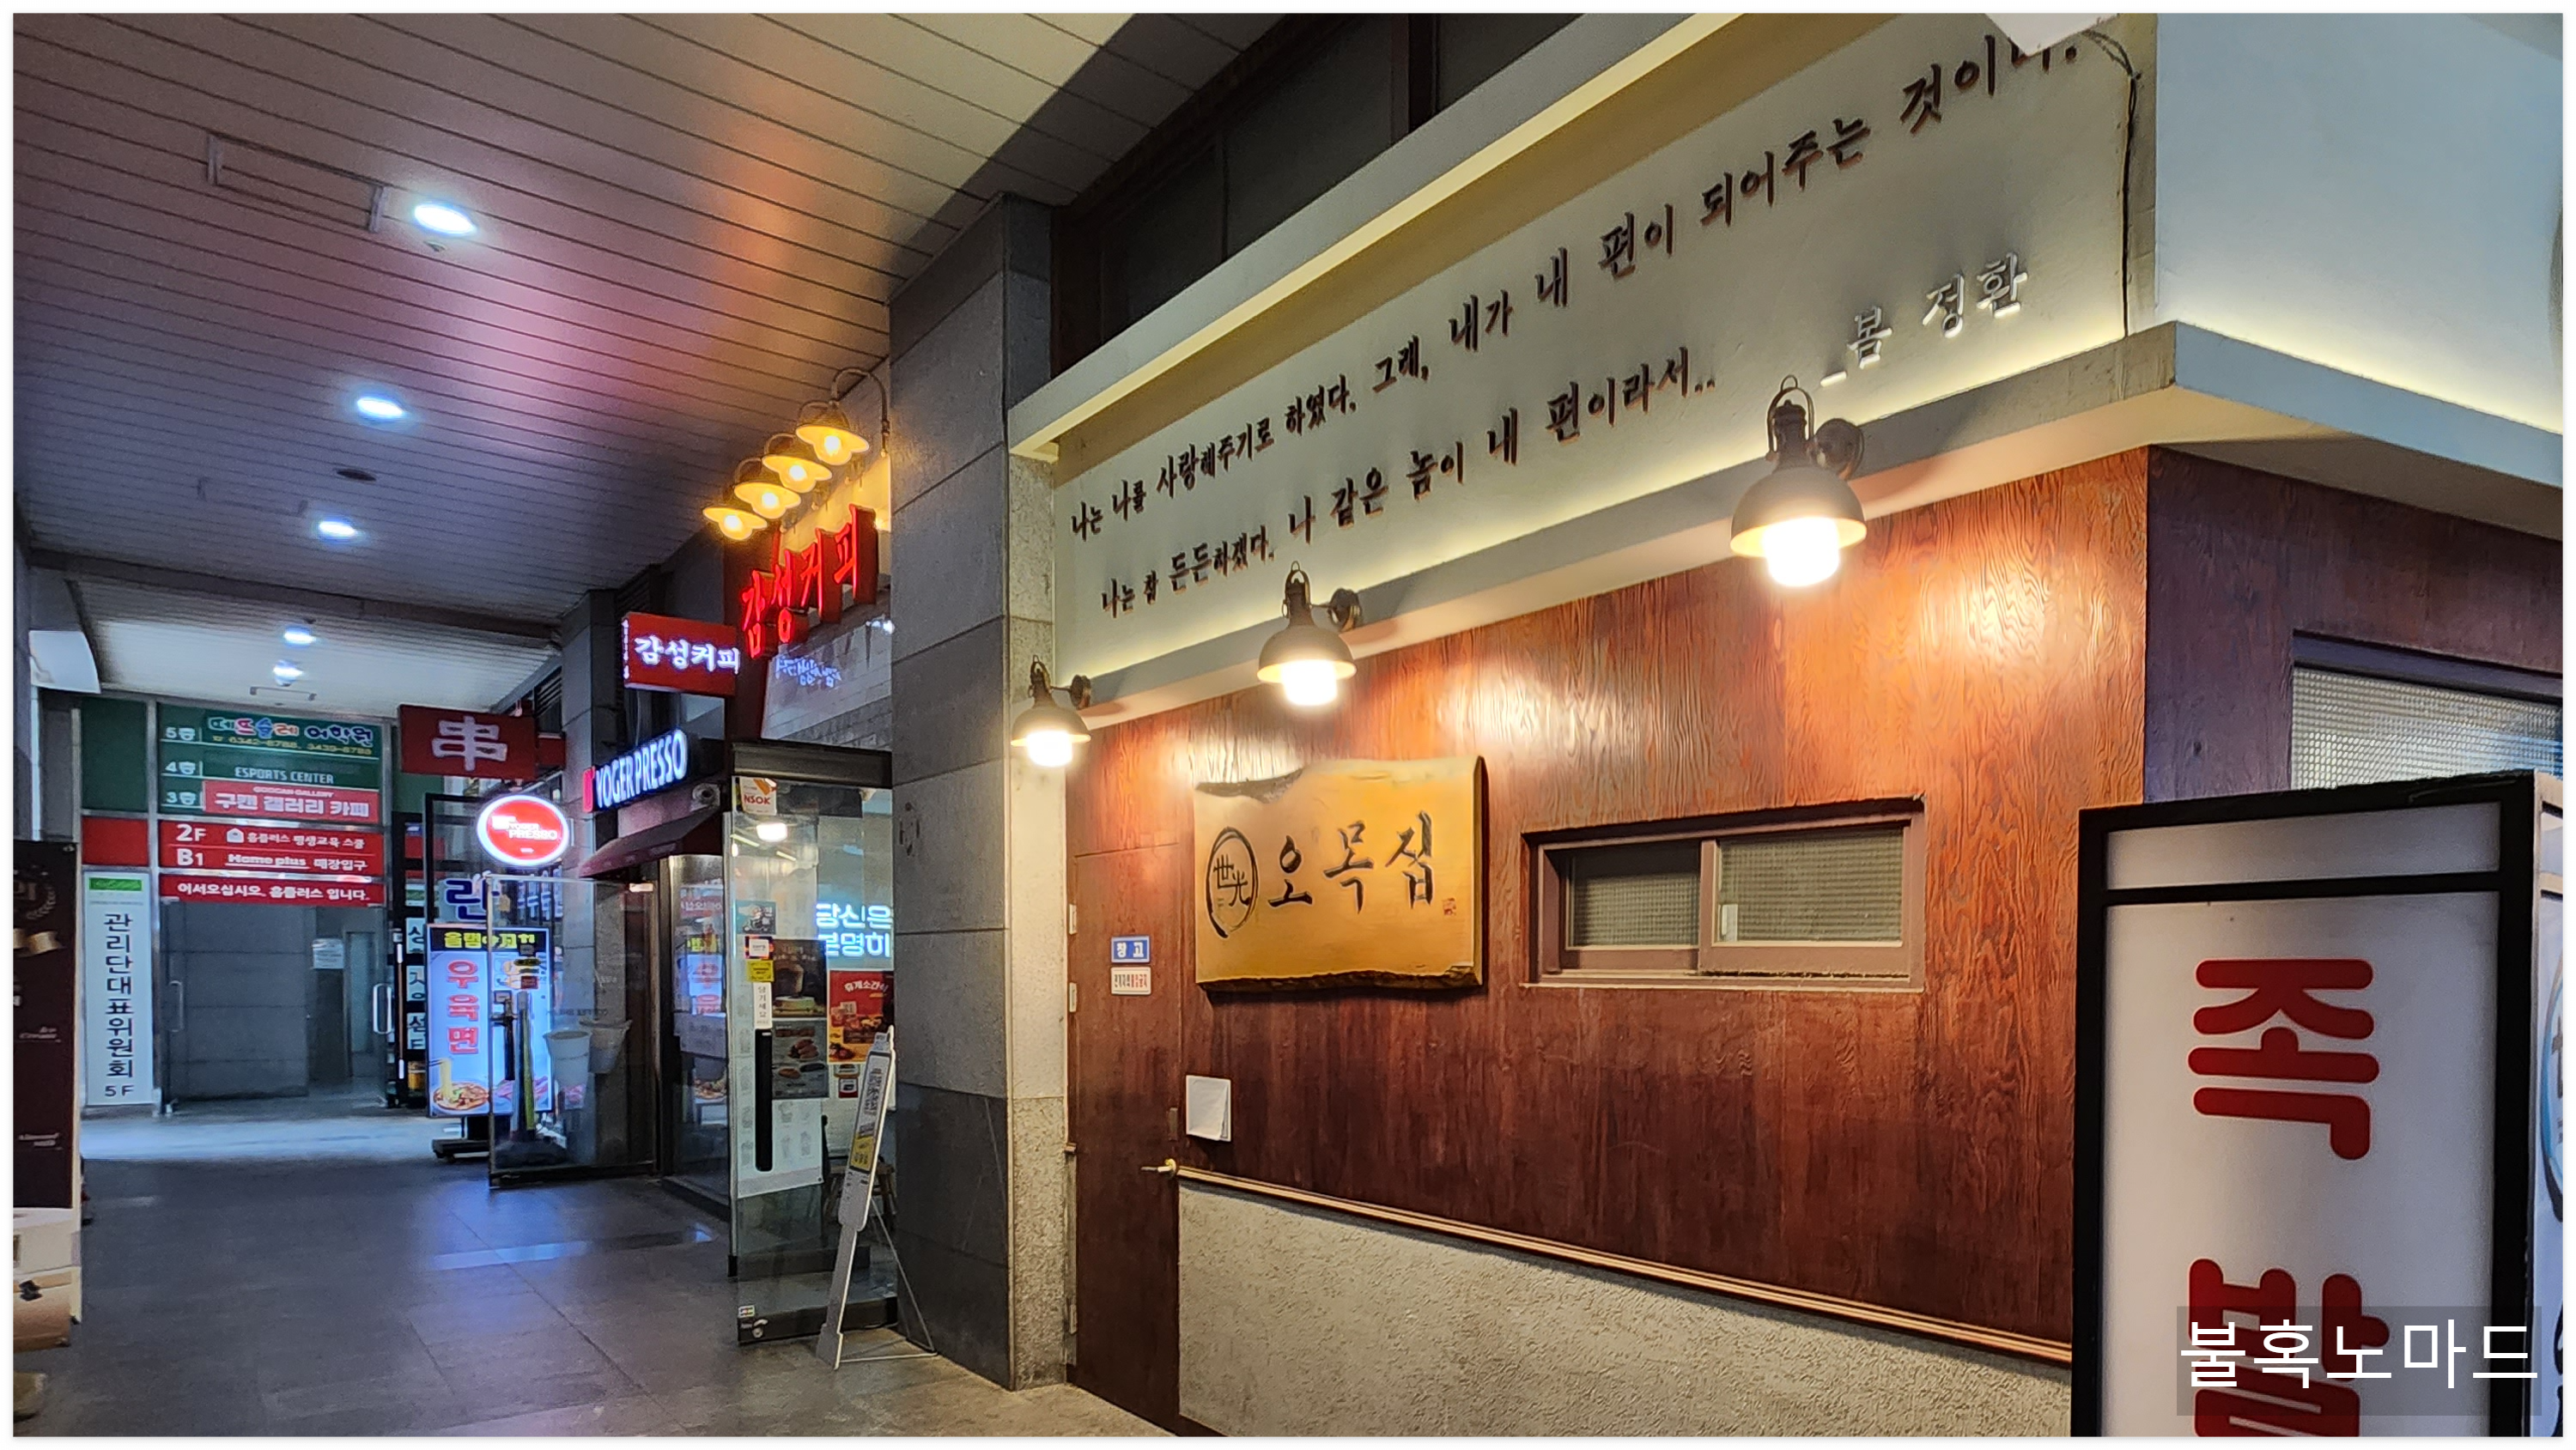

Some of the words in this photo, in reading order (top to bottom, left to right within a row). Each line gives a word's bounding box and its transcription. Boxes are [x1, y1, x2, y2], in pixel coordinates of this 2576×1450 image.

[1071, 501, 1103, 542] 나는
[1112, 480, 1147, 521] 나를
[1156, 416, 1275, 498] 사랑해주기로
[1285, 373, 1357, 435] 하였다.
[1373, 335, 1430, 392] 그래,
[1448, 288, 1514, 352] 내가
[1534, 246, 1569, 307] 내
[1598, 203, 1674, 280] 편이
[1699, 117, 1871, 228] 되어주는
[1101, 577, 1136, 619] 나는
[1143, 570, 1159, 605] 참
[1169, 525, 1275, 595] 든든하겠다.
[1288, 495, 1315, 544] 나
[1329, 466, 1389, 530] 같은
[1406, 440, 1464, 502] 놈이
[1486, 407, 1518, 466] 내
[741, 503, 866, 660] 감성커피
[634, 634, 741, 675] 감성커피
[166, 726, 196, 741] 5층
[304, 724, 374, 748] 어학원
[431, 714, 508, 772] 串
[165, 761, 197, 775] 4층
[234, 767, 288, 780] ESPORTS
[289, 771, 334, 784] CENTER
[166, 792, 197, 805] 3층
[263, 796, 325, 815] 갤러리
[330, 800, 370, 818] 카페
[744, 794, 771, 805] NSOK
[175, 823, 207, 842] 2F
[247, 831, 291, 844] 홈플러스
[176, 847, 204, 867] B1
[228, 853, 274, 865] Home
[275, 856, 307, 867] plus
[313, 858, 369, 872] 매장입구
[1267, 810, 1434, 915] 오목집
[269, 885, 325, 899] 홈플러스
[815, 902, 894, 930] 당신은
[103, 913, 135, 1078] 관리단대표위원회
[446, 959, 480, 1056] 우육면
